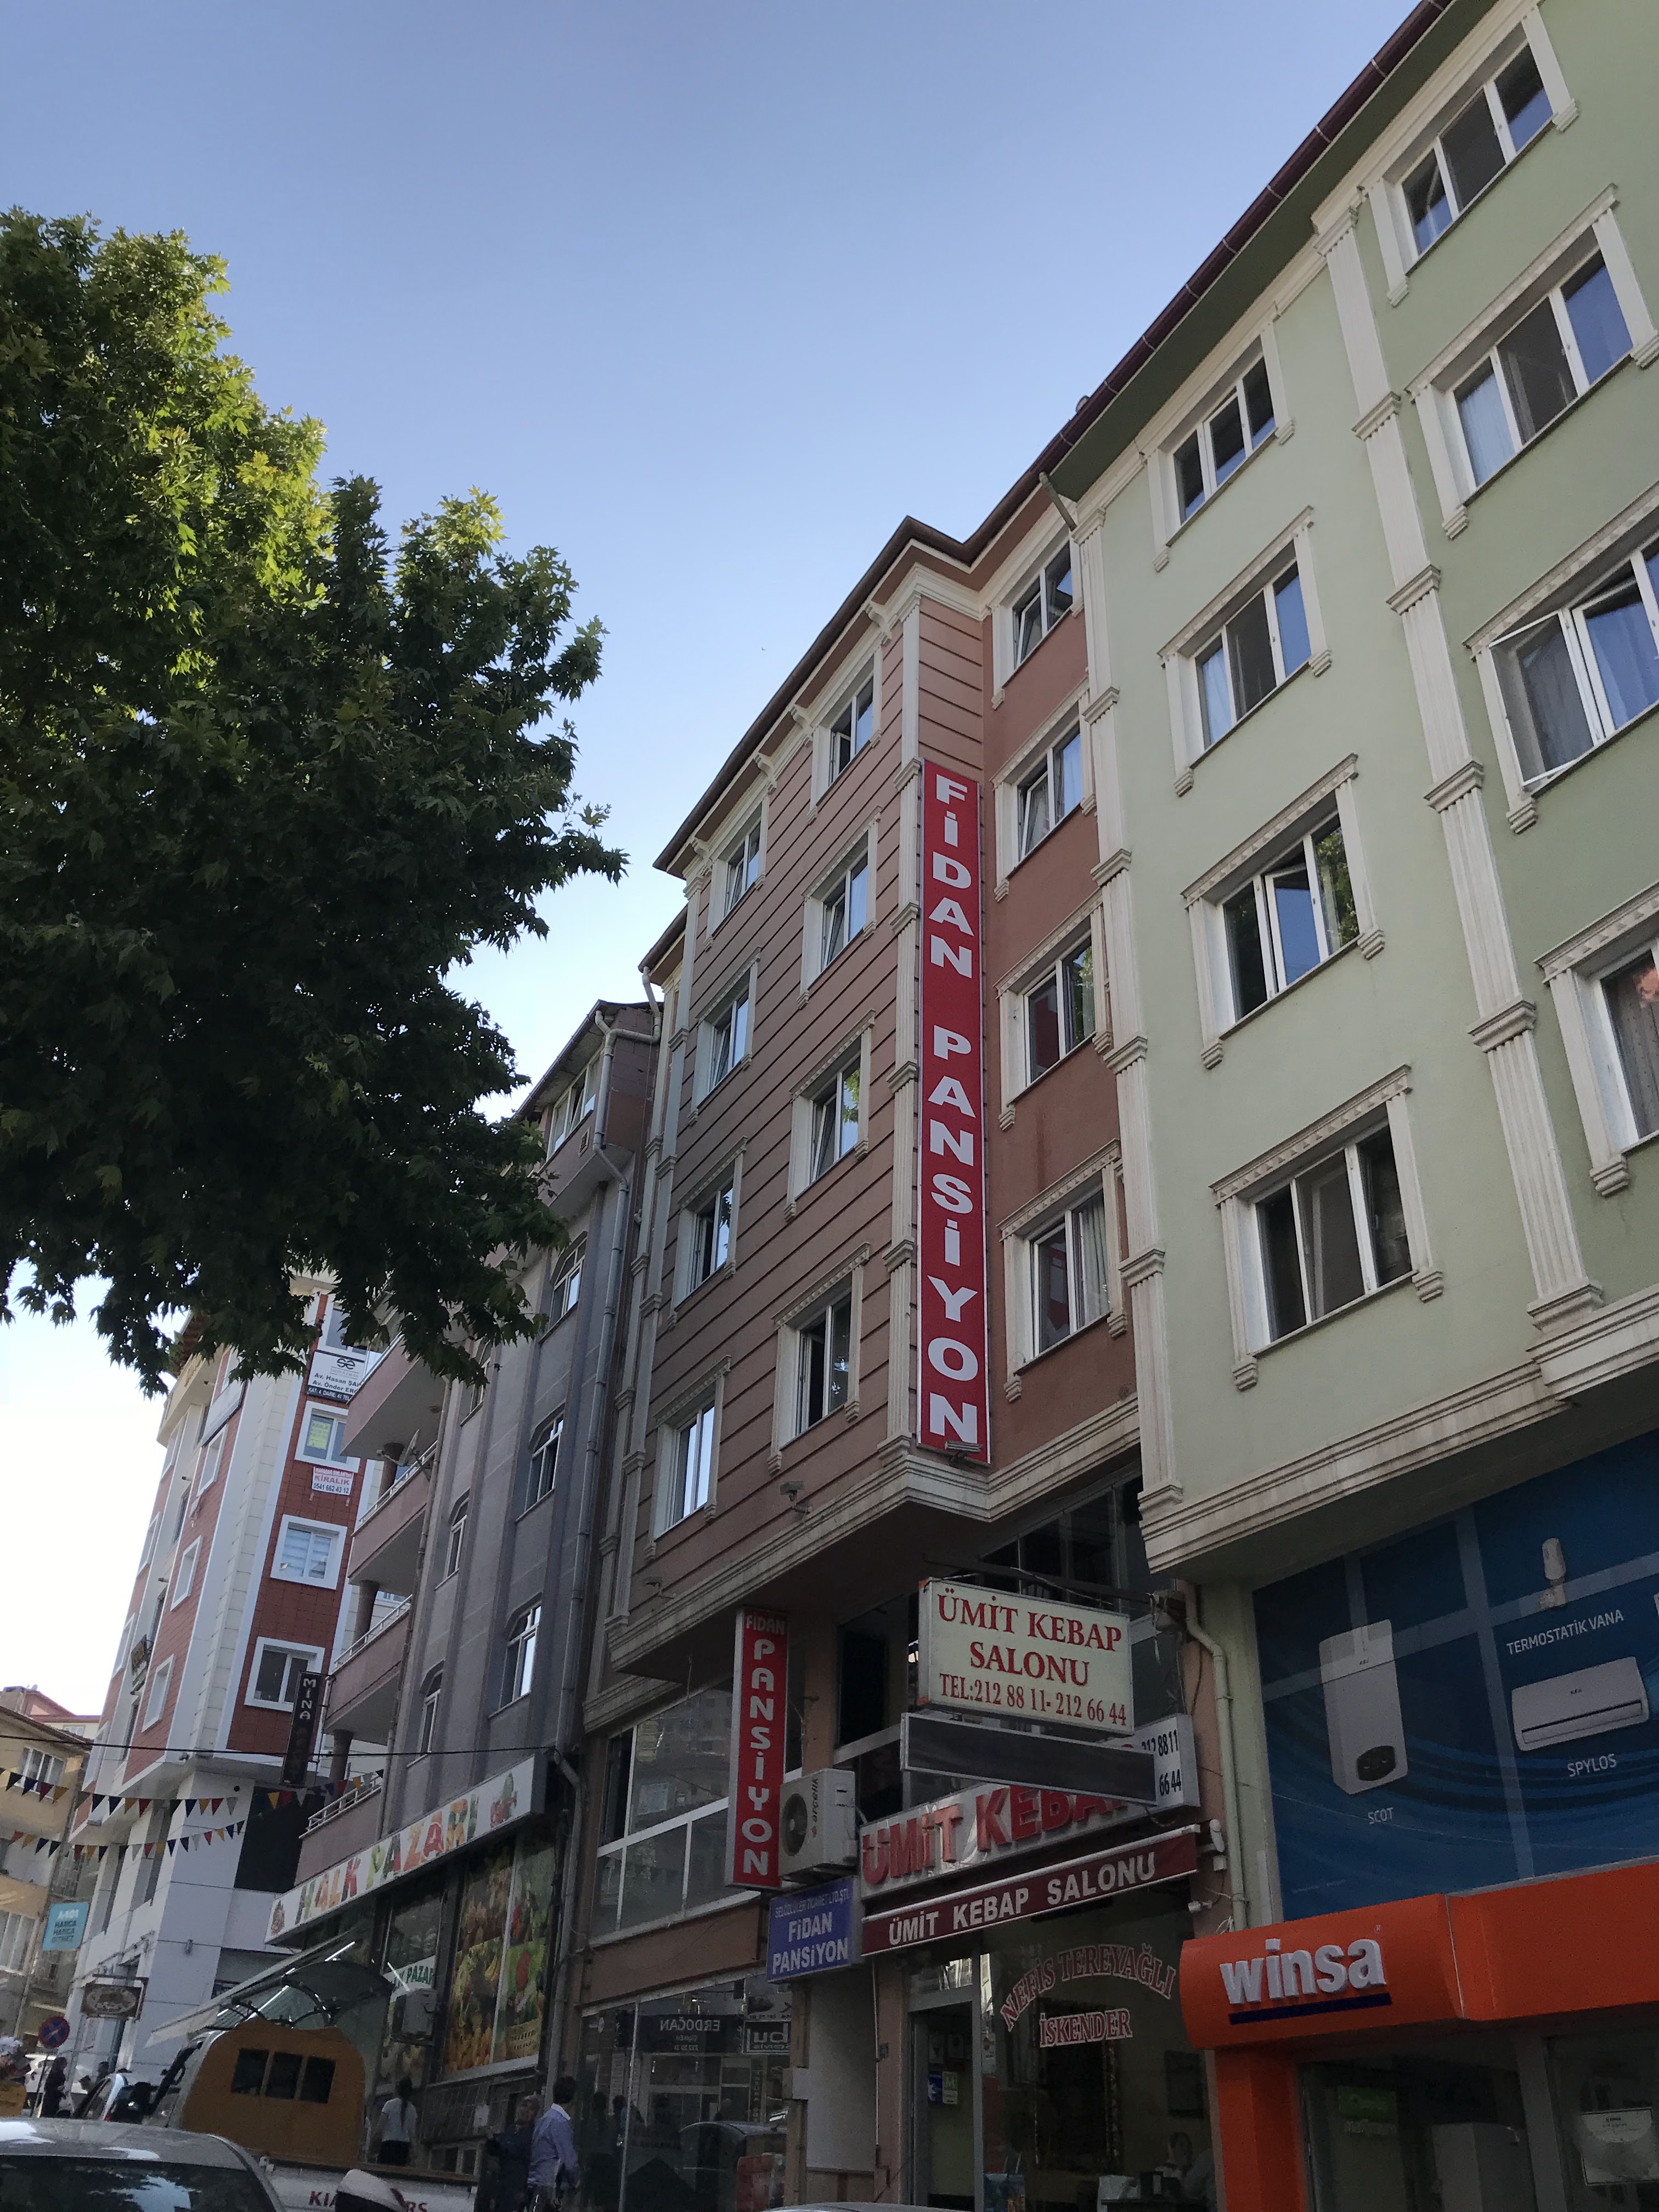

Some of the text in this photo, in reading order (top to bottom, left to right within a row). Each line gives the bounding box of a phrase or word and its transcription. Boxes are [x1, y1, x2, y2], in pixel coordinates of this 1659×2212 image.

[928, 773, 978, 1443] FİDAN PANSİYON
[324, 1381, 344, 1391] Önder
[326, 1375, 346, 1384] Hasan
[314, 1475, 349, 1485] KİRALIK
[938, 1587, 1121, 1652] ÜMİT KEBAP
[1506, 1609, 1624, 1655] TERMOSTATİK VANA
[970, 1641, 1090, 1686] SALONU
[300, 1678, 317, 1720] MİNA
[1007, 1684, 1024, 1708] 88
[1056, 1692, 1082, 1718] 212
[1087, 1698, 1104, 1722] 66
[1109, 1702, 1126, 1726] 44
[741, 1638, 775, 1876] PANSİYON
[1567, 1753, 1617, 1778] SPYLOS
[862, 1784, 1127, 1885] ÜMİT KEBA
[1368, 1807, 1393, 1825] SCOT
[295, 1793, 479, 1925] HALK PAZARI
[888, 1852, 1155, 1945] ÜMİT KEBAP SALONU
[788, 1911, 832, 1942] FİDAN
[772, 1937, 848, 1974] PANSİYON
[1058, 1942, 1177, 2000] TEREYAĞLI
[1220, 1938, 1386, 2005] winsa
[1039, 2008, 1133, 2048] İSKENDER
